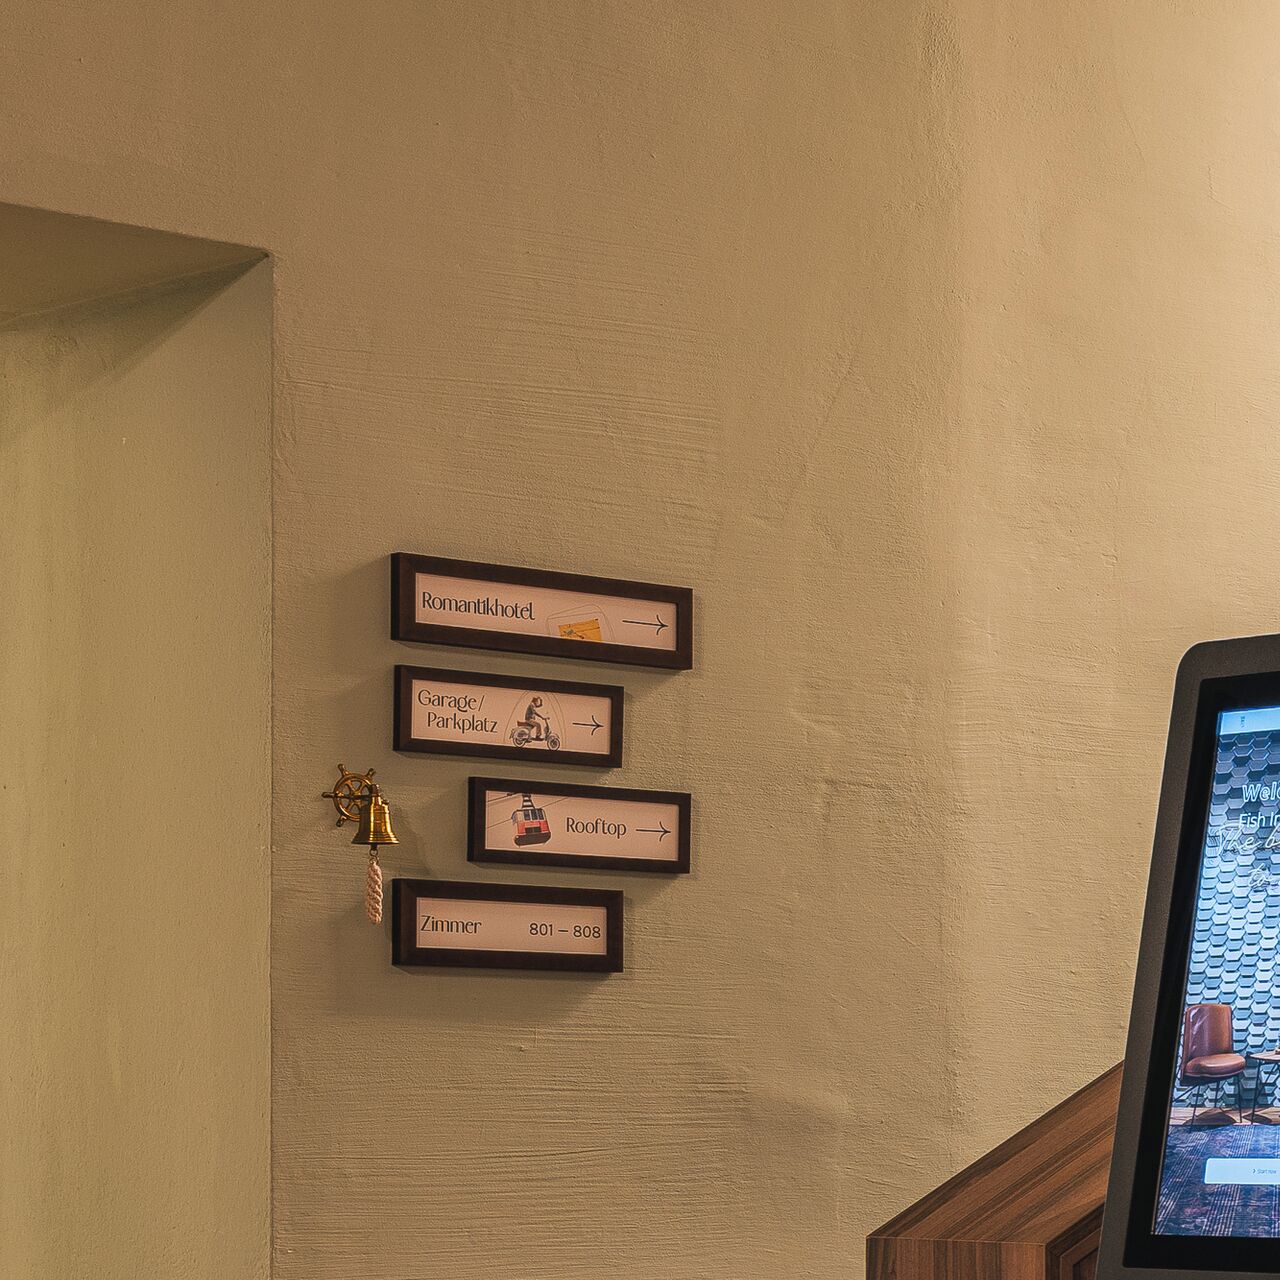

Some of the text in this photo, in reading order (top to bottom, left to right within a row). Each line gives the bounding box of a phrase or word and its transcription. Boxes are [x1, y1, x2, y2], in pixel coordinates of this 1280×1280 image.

[422, 591, 535, 620] Romantikhotel
[418, 689, 485, 712] Garage/
[427, 711, 498, 734] Parkplatz
[566, 817, 627, 839] Rooftop
[1240, 812, 1266, 828] Fish
[420, 915, 482, 934] Zimmer
[529, 923, 553, 936] 801
[573, 925, 601, 938] 808
